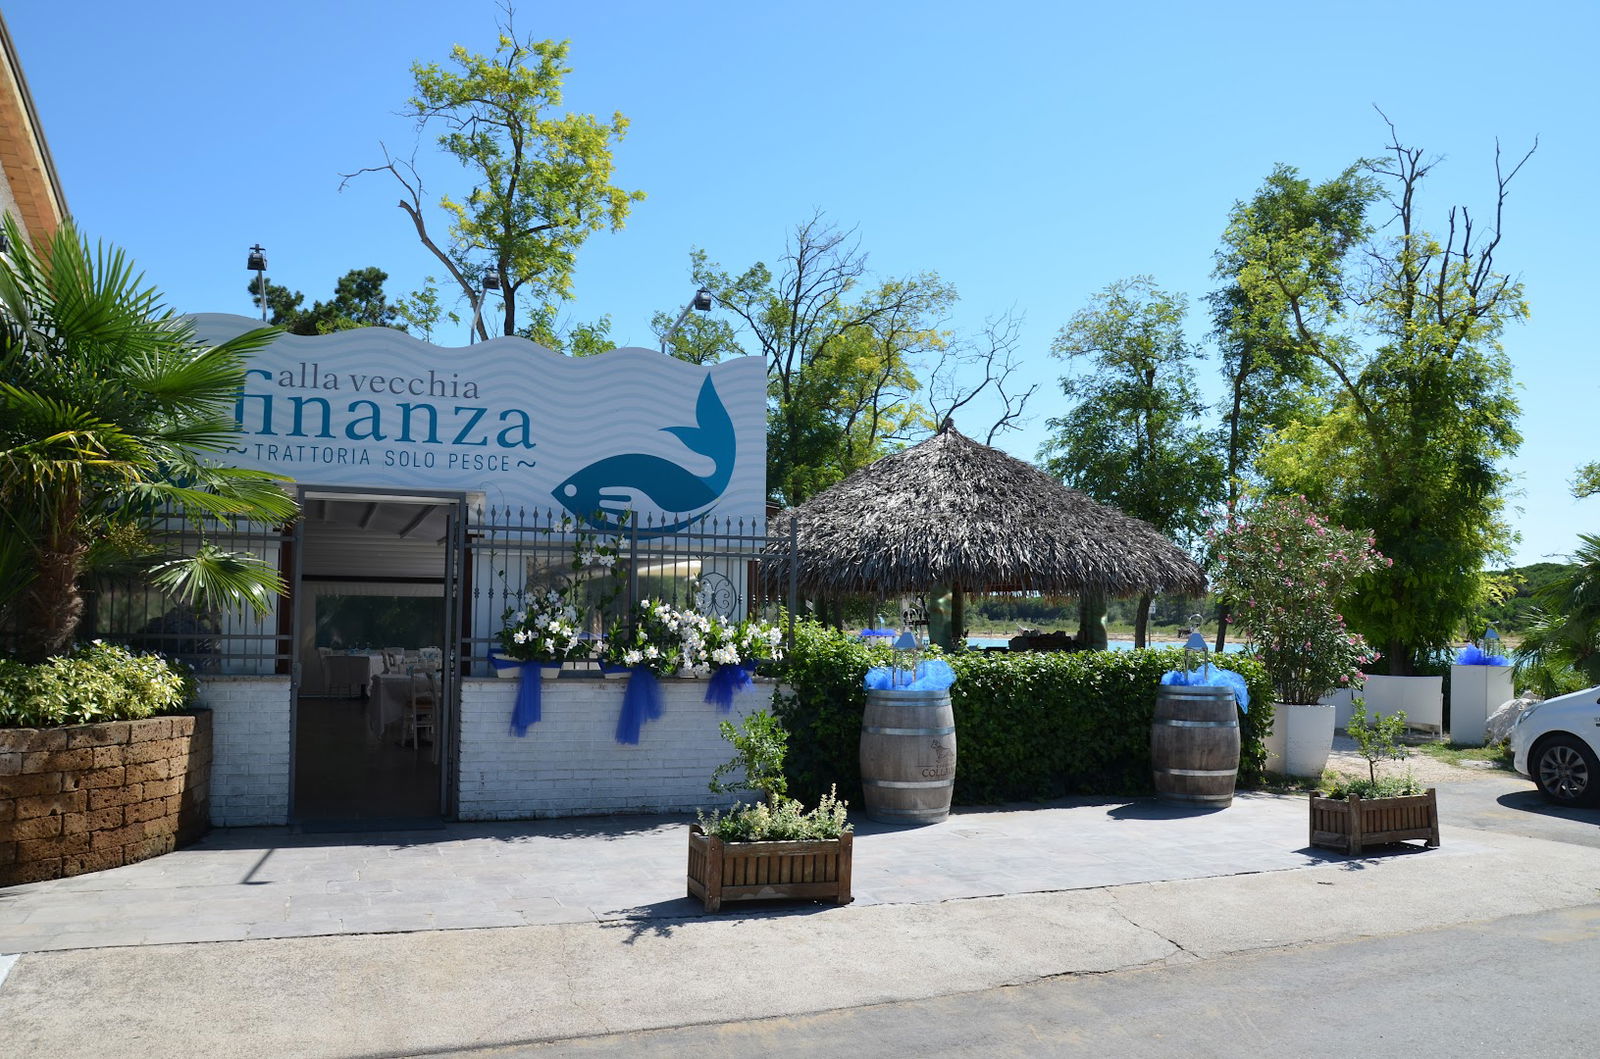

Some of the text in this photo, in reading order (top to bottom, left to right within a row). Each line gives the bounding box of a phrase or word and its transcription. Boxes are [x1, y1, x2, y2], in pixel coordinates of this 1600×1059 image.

[278, 362, 480, 399] alla vecchia
[255, 443, 509, 472] TRATTORIA SOLO PESCE
